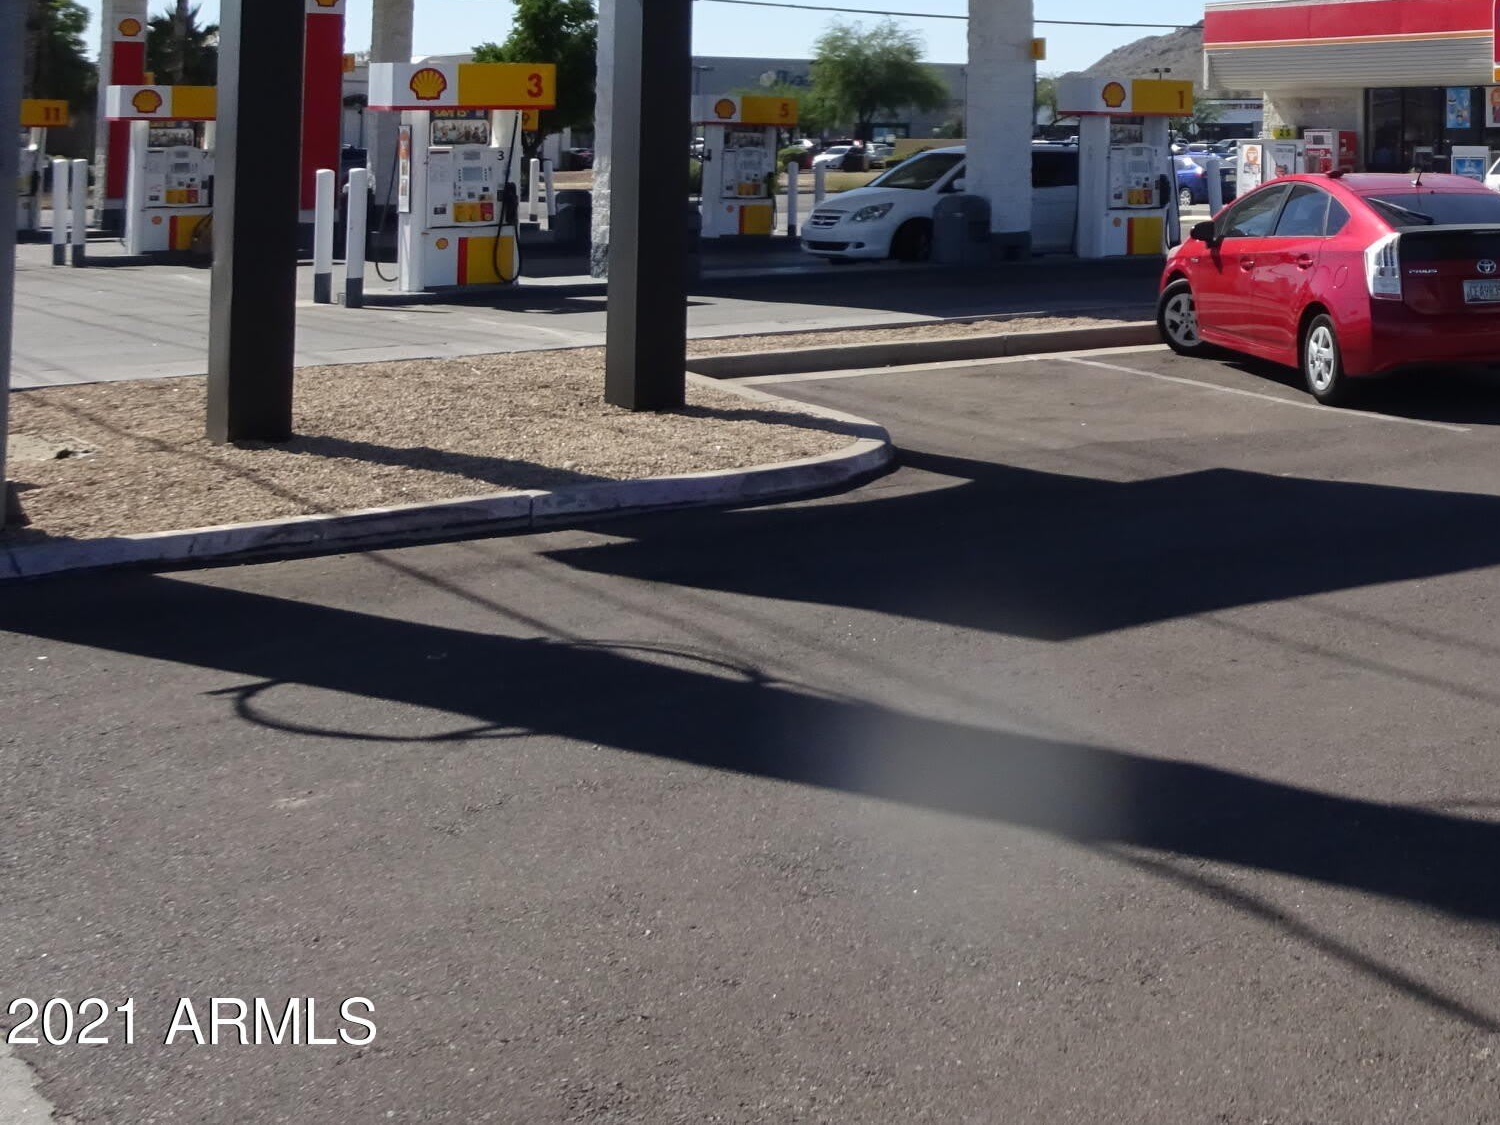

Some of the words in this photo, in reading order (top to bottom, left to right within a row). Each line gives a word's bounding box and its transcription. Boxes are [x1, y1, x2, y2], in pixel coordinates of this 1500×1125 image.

[527, 72, 544, 99] 3
[1177, 90, 1185, 110] 1
[780, 102, 790, 118] 5
[497, 150, 505, 161] 3
